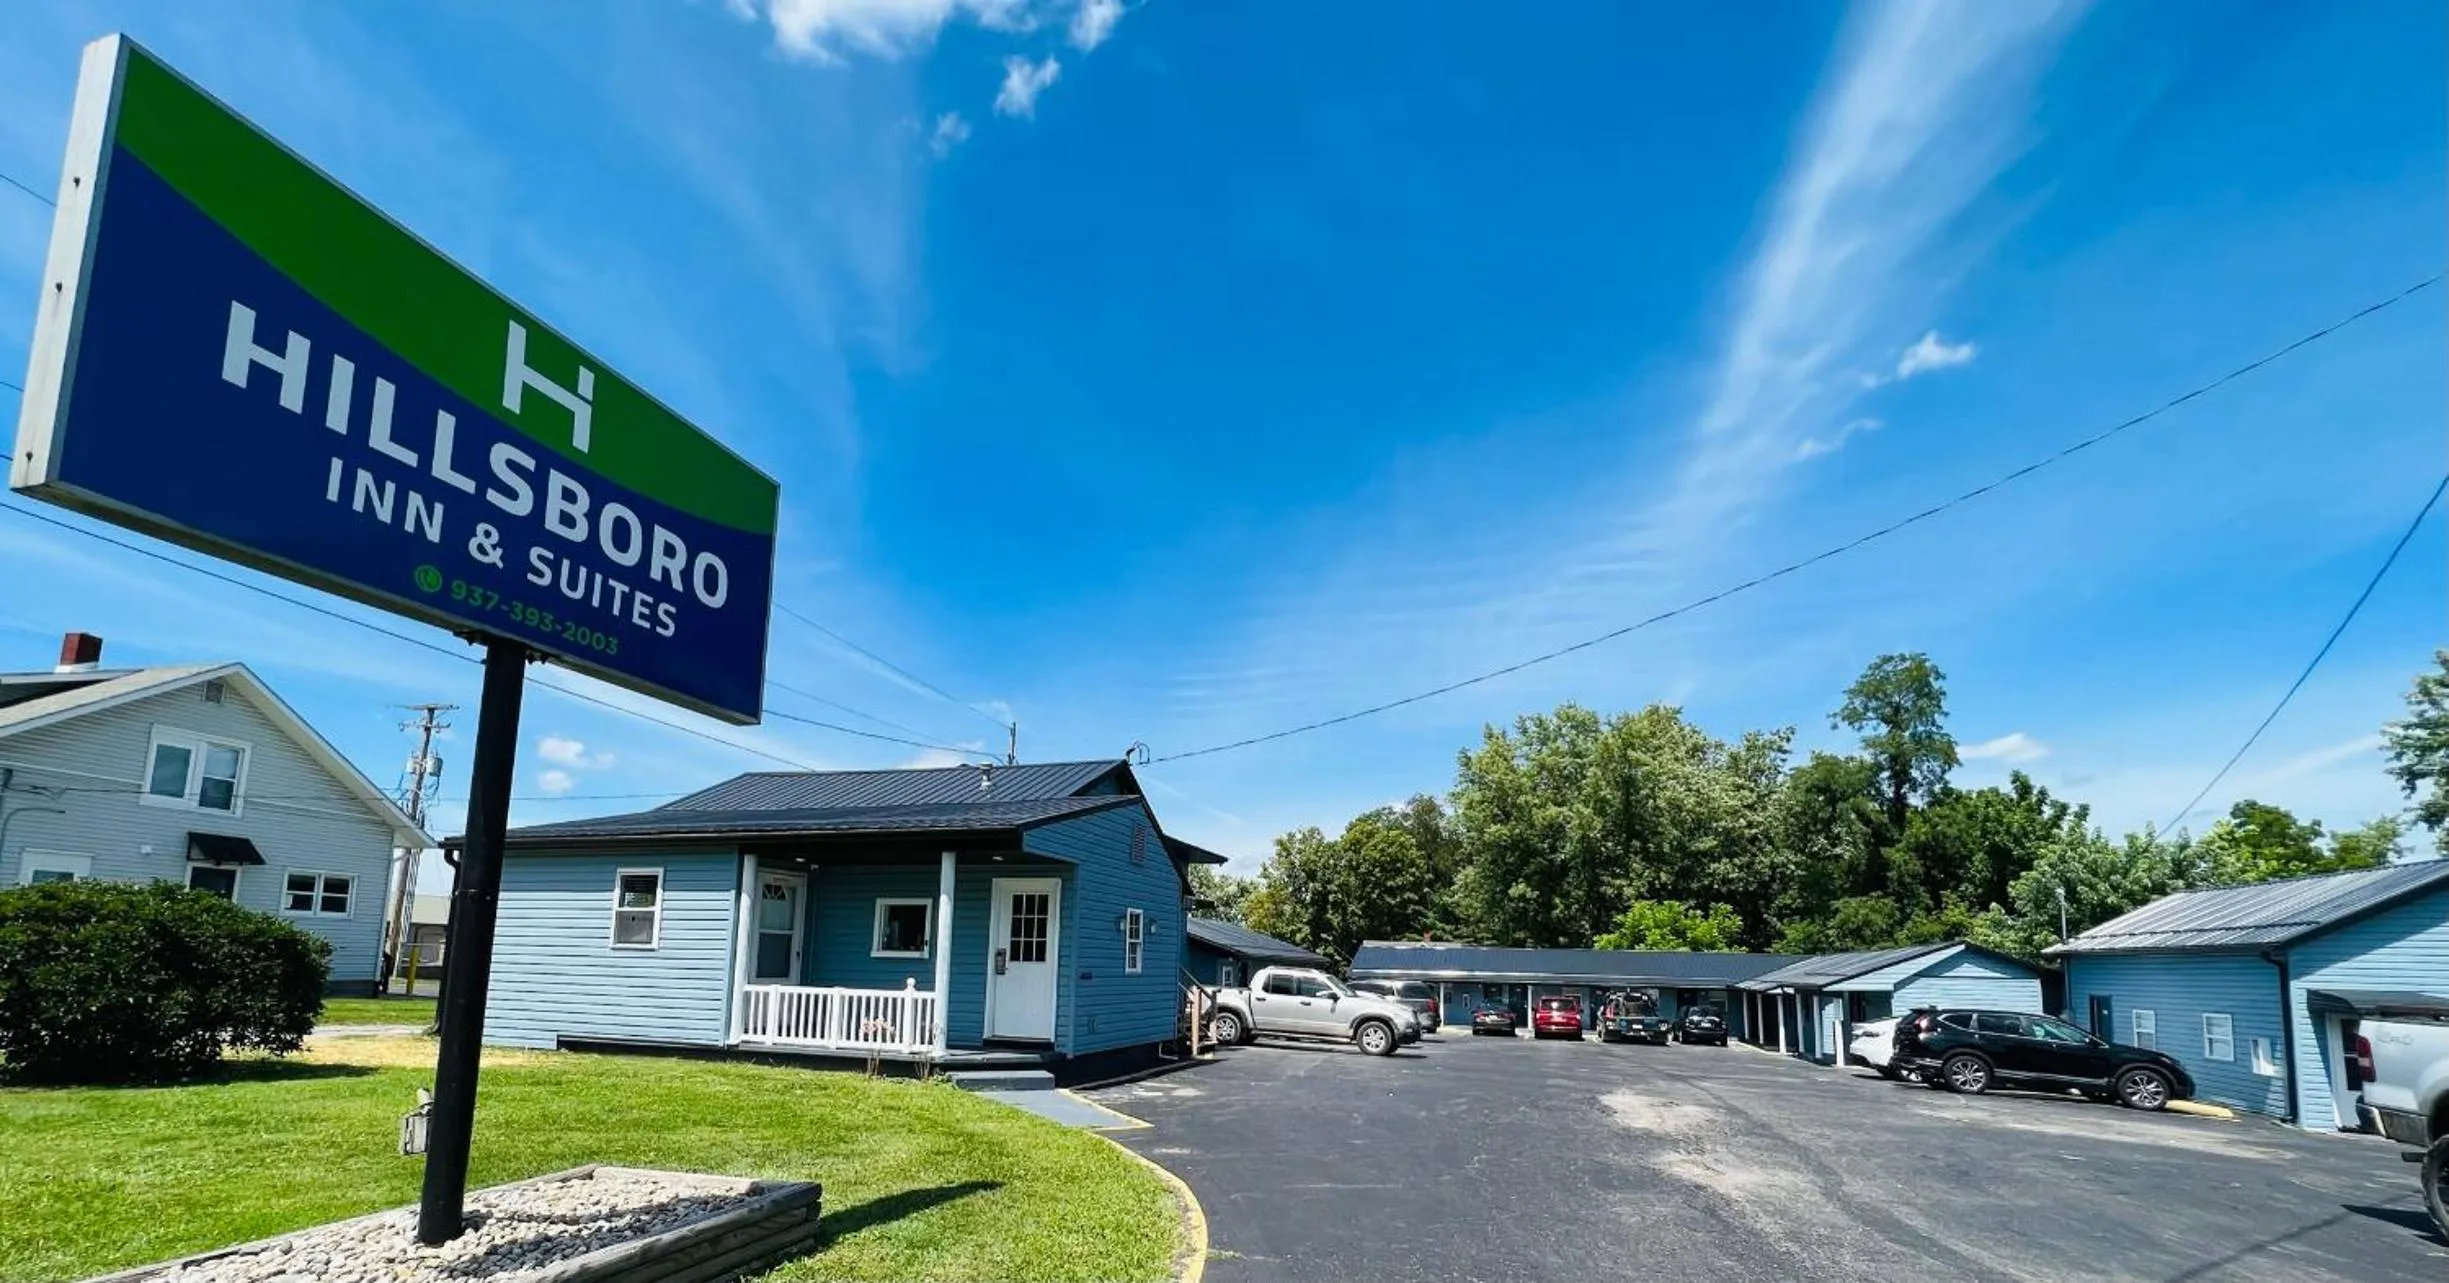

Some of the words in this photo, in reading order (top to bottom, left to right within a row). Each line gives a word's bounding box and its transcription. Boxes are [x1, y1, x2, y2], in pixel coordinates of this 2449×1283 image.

[223, 301, 727, 607] HILLSBORO
[327, 458, 443, 542] INN
[469, 523, 503, 568] &
[527, 547, 676, 636] SUITES
[452, 581, 619, 655] 937-393-2003
